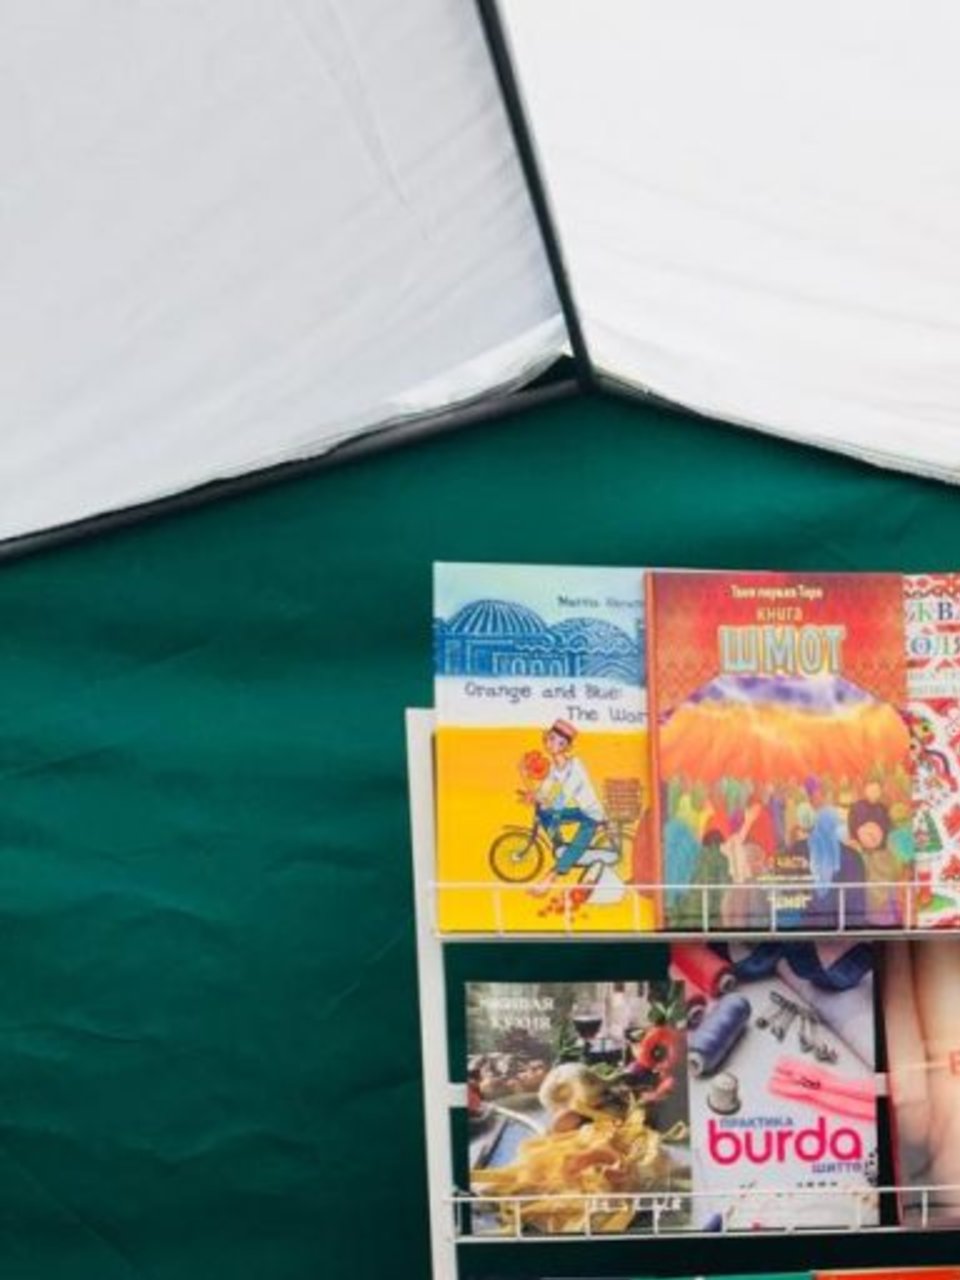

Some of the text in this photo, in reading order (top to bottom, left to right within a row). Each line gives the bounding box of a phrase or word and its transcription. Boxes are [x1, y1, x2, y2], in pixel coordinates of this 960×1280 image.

[717, 624, 847, 674] ШМОТ
[465, 682, 532, 703] Orange
[542, 681, 576, 698] and
[567, 704, 597, 722] The
[708, 1116, 862, 1165] burda
